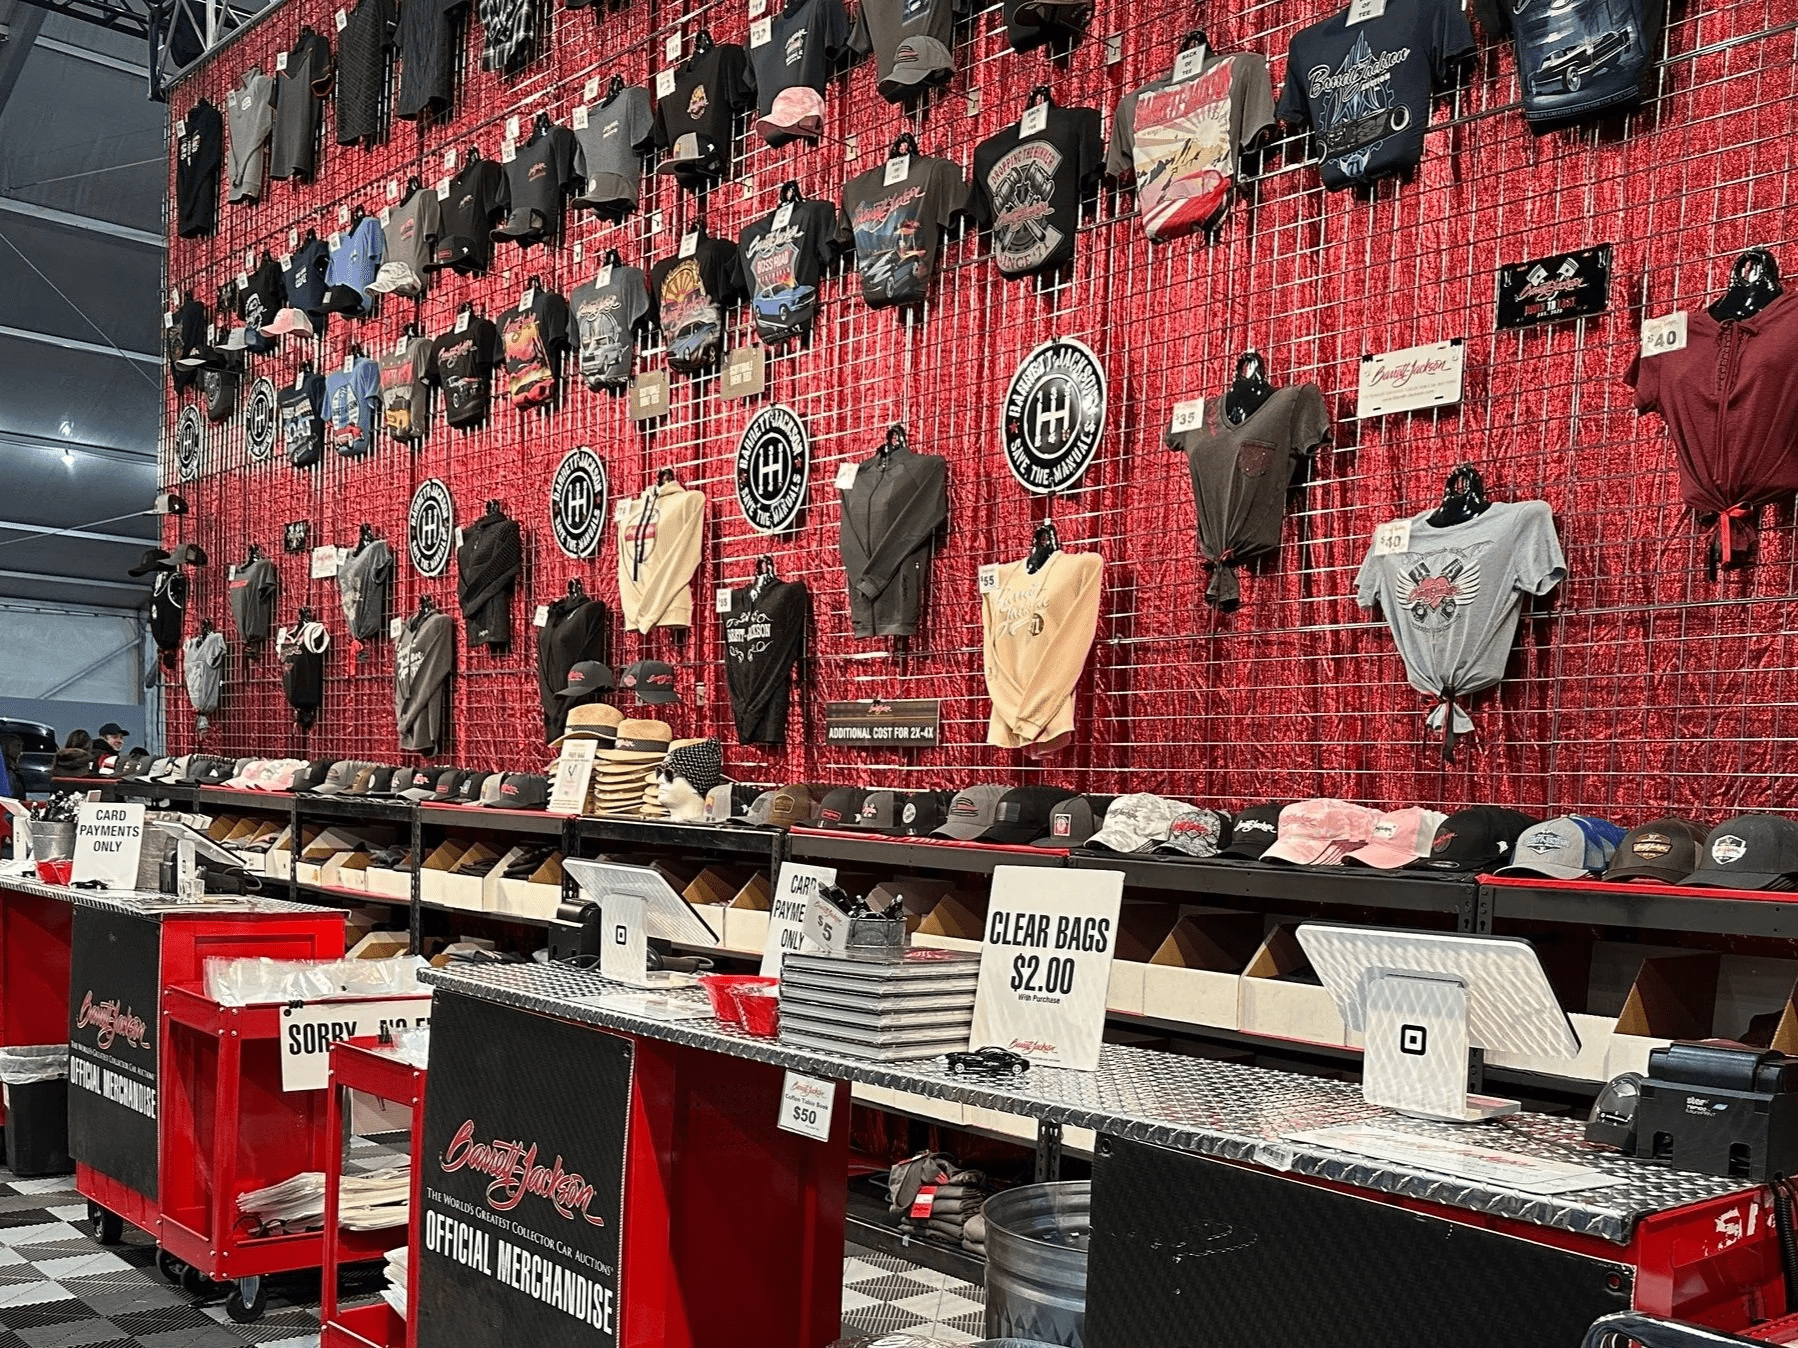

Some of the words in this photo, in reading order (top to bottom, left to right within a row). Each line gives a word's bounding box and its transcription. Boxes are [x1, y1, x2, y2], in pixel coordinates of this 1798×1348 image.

[1647, 330, 1677, 349] $40
[1368, 357, 1452, 388] Barrett-Jackson
[1175, 412, 1195, 425] $35
[1011, 438, 1030, 474] SAVE
[1030, 465, 1050, 485] THE
[1052, 420, 1097, 483] MANUALS
[980, 575, 995, 587] $55
[828, 727, 871, 738] ADDITIONAL
[873, 727, 893, 738] COST
[894, 727, 909, 738] FOR
[910, 727, 934, 738] 2X-4X
[96, 810, 127, 821] CARD
[79, 825, 140, 837] PAYMENTS
[93, 841, 122, 852] ONLY
[791, 875, 817, 895] CARD
[781, 928, 805, 951] ONLY
[818, 915, 832, 942] $5
[989, 911, 1050, 948] CLEAR
[1055, 915, 1110, 953] BAGS
[1010, 953, 1075, 994] $2.00
[1033, 994, 1060, 1004] Purchase
[288, 1021, 357, 1055] SORRY
[71, 1055, 101, 1095] OFFICIAL
[103, 1068, 156, 1120] MERCHANDISE
[793, 1106, 817, 1124] $50
[440, 1119, 605, 1228] Barrett-Jackson
[426, 1187, 442, 1203] THE
[443, 1193, 474, 1216] WORLD'S
[475, 1206, 511, 1231] GREATEST
[512, 1221, 555, 1250] COLLECTOR
[556, 1240, 573, 1258] CAR
[426, 1210, 492, 1276] OFFICIAL
[497, 1239, 613, 1336] MERCHANDISE
